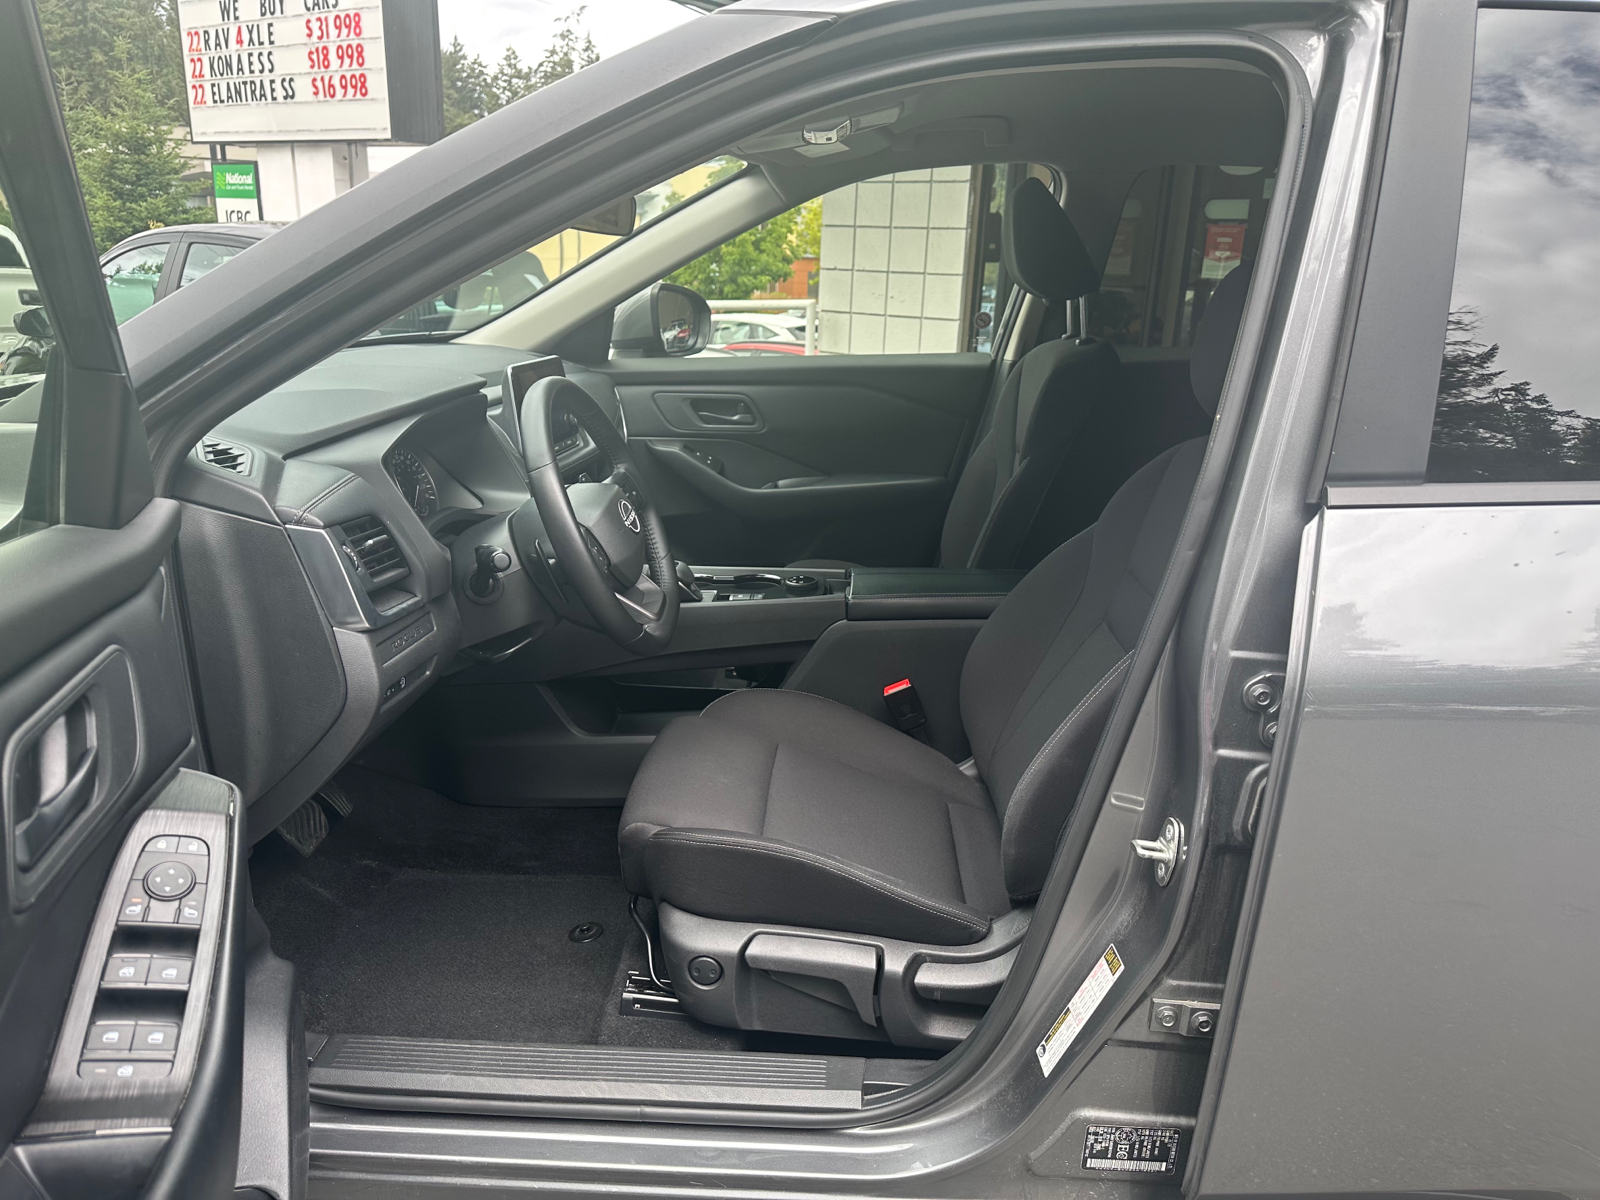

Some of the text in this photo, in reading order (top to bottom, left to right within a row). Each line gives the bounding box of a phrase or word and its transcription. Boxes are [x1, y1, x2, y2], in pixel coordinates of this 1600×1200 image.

[219, 0, 240, 22] WE
[260, 0, 284, 17] BUY
[187, 30, 202, 53] 22
[190, 57, 205, 79] 22
[191, 84, 207, 105] 22
[225, 172, 253, 184] National
